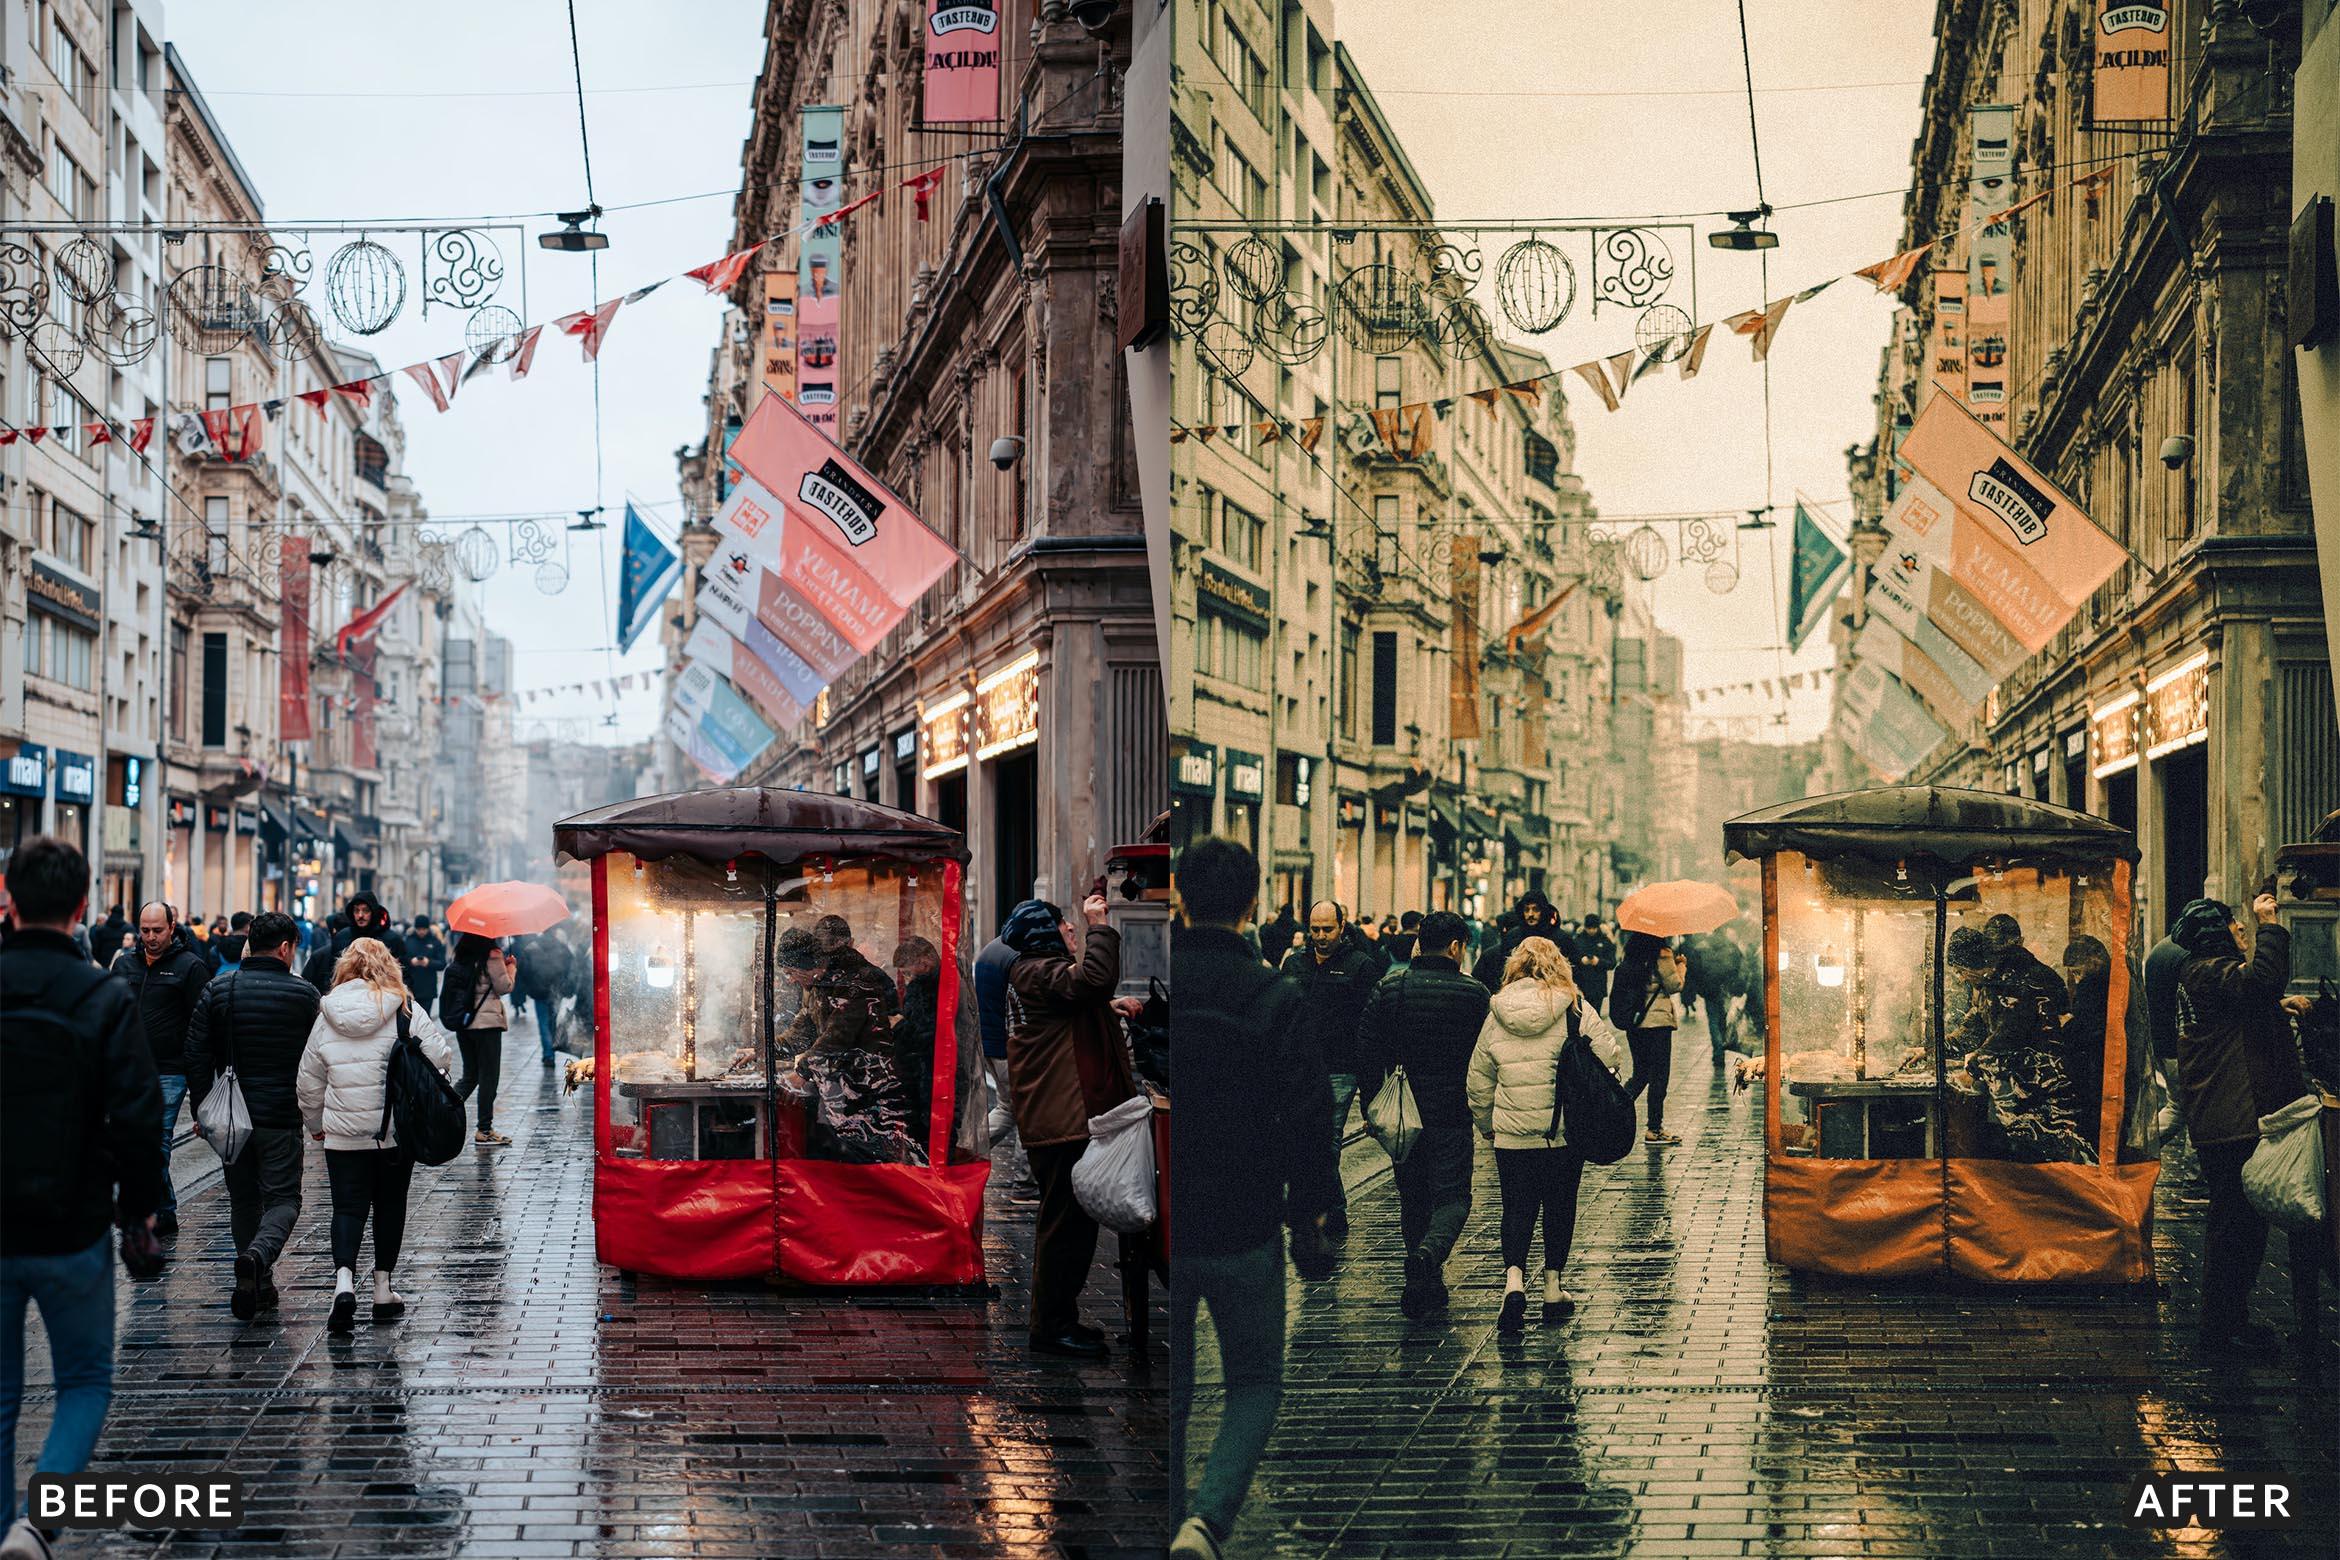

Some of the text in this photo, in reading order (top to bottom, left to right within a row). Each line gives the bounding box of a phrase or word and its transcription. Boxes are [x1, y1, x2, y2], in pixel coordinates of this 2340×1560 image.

[938, 10, 991, 29] TASTEHUB
[2108, 9, 2161, 28] TASTEHUB
[808, 481, 868, 536] TASTEHUB
[1978, 480, 2038, 535] TASTEHUB
[9, 751, 42, 787] mavi
[63, 762, 92, 795] mavi
[1179, 750, 1212, 786] mavi
